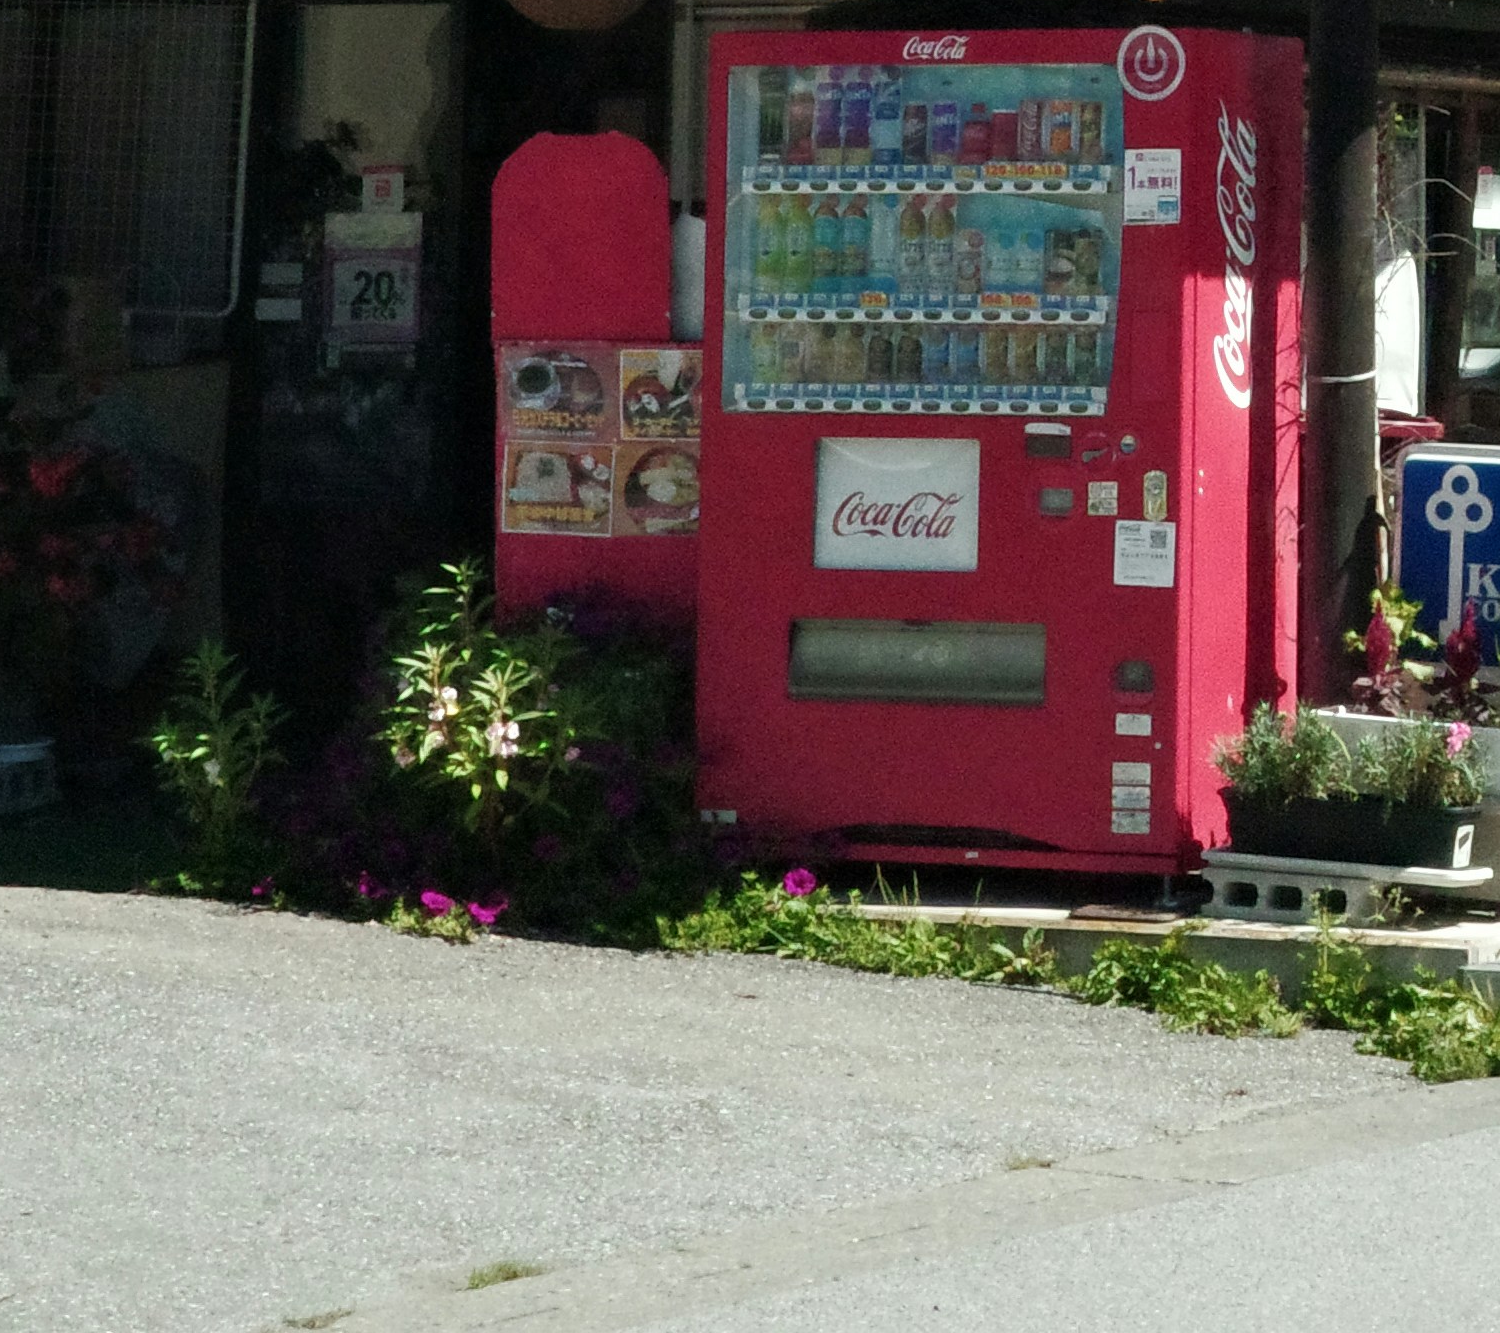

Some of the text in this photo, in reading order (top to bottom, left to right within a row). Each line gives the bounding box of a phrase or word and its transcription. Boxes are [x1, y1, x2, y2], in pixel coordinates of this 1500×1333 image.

[902, 35, 970, 60] Coca-Cola
[1213, 98, 1257, 409] Coca-Cola
[351, 270, 395, 306] 20
[832, 491, 965, 539] Coca-Cola
